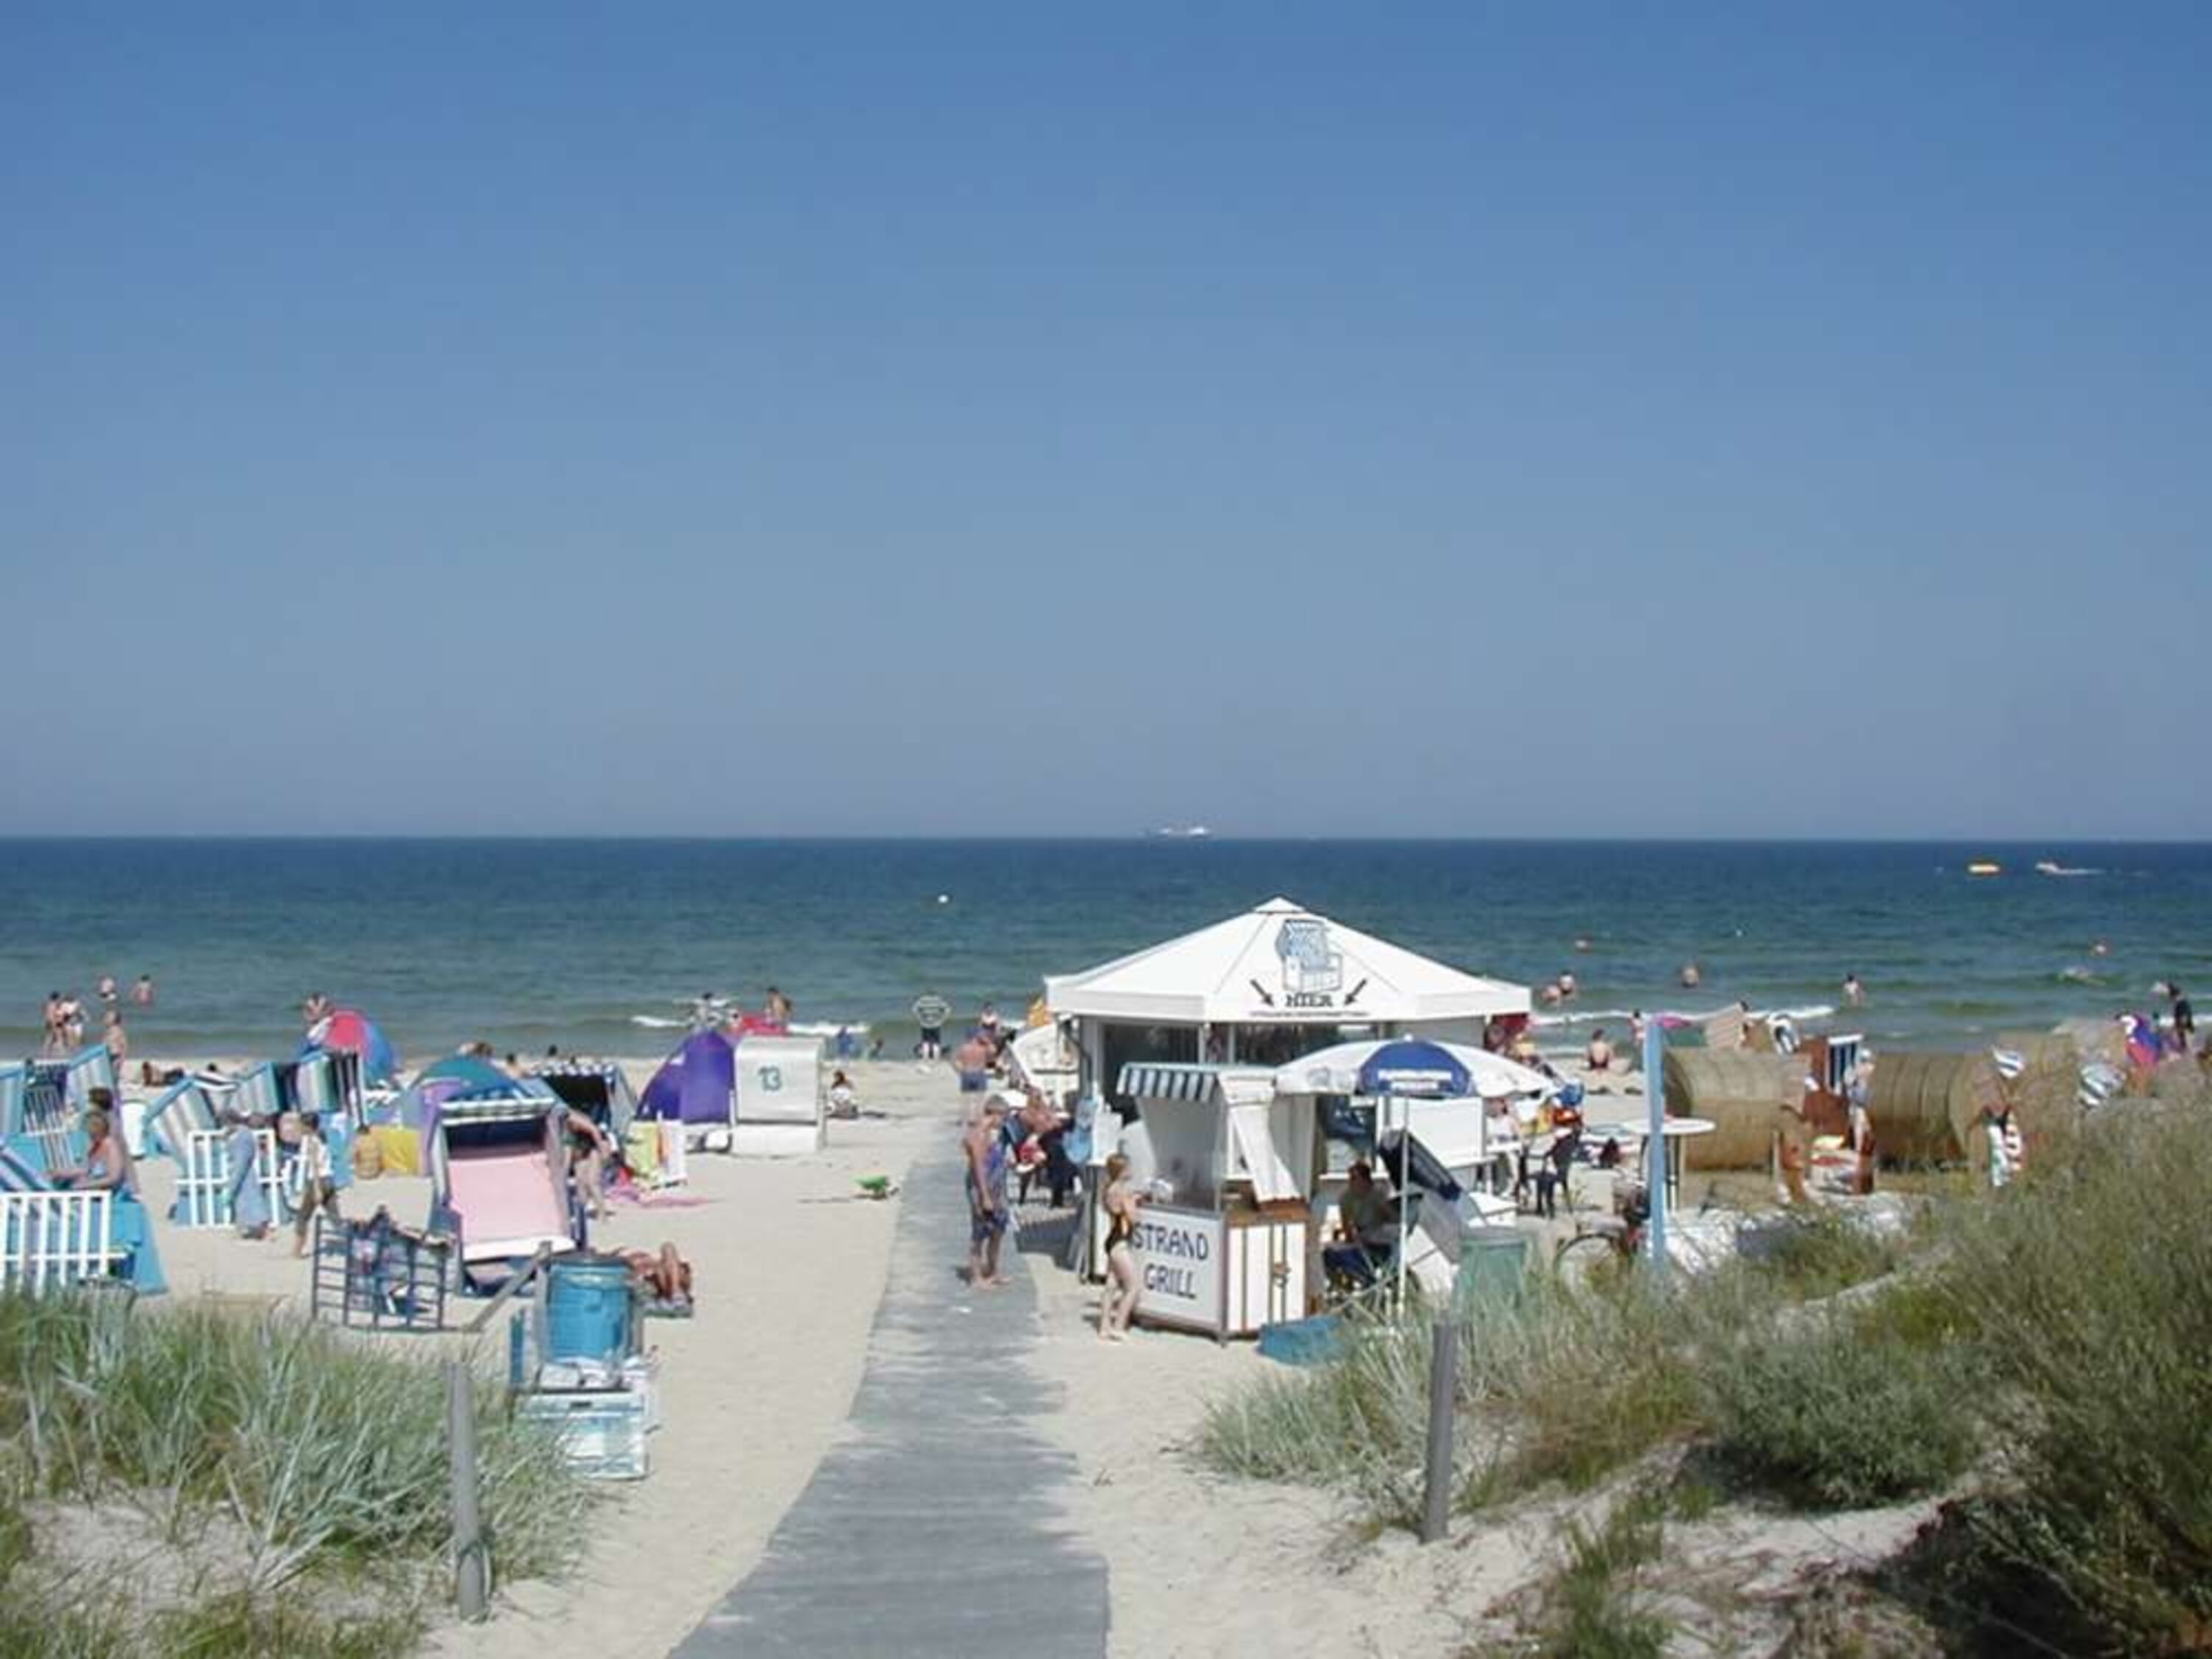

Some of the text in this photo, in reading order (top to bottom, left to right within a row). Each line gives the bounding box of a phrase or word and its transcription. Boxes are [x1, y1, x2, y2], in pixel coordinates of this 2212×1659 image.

[757, 1065, 782, 1092] 13
[1132, 1221, 1209, 1262] STRAND
[1144, 1262, 1197, 1299] GRILL
